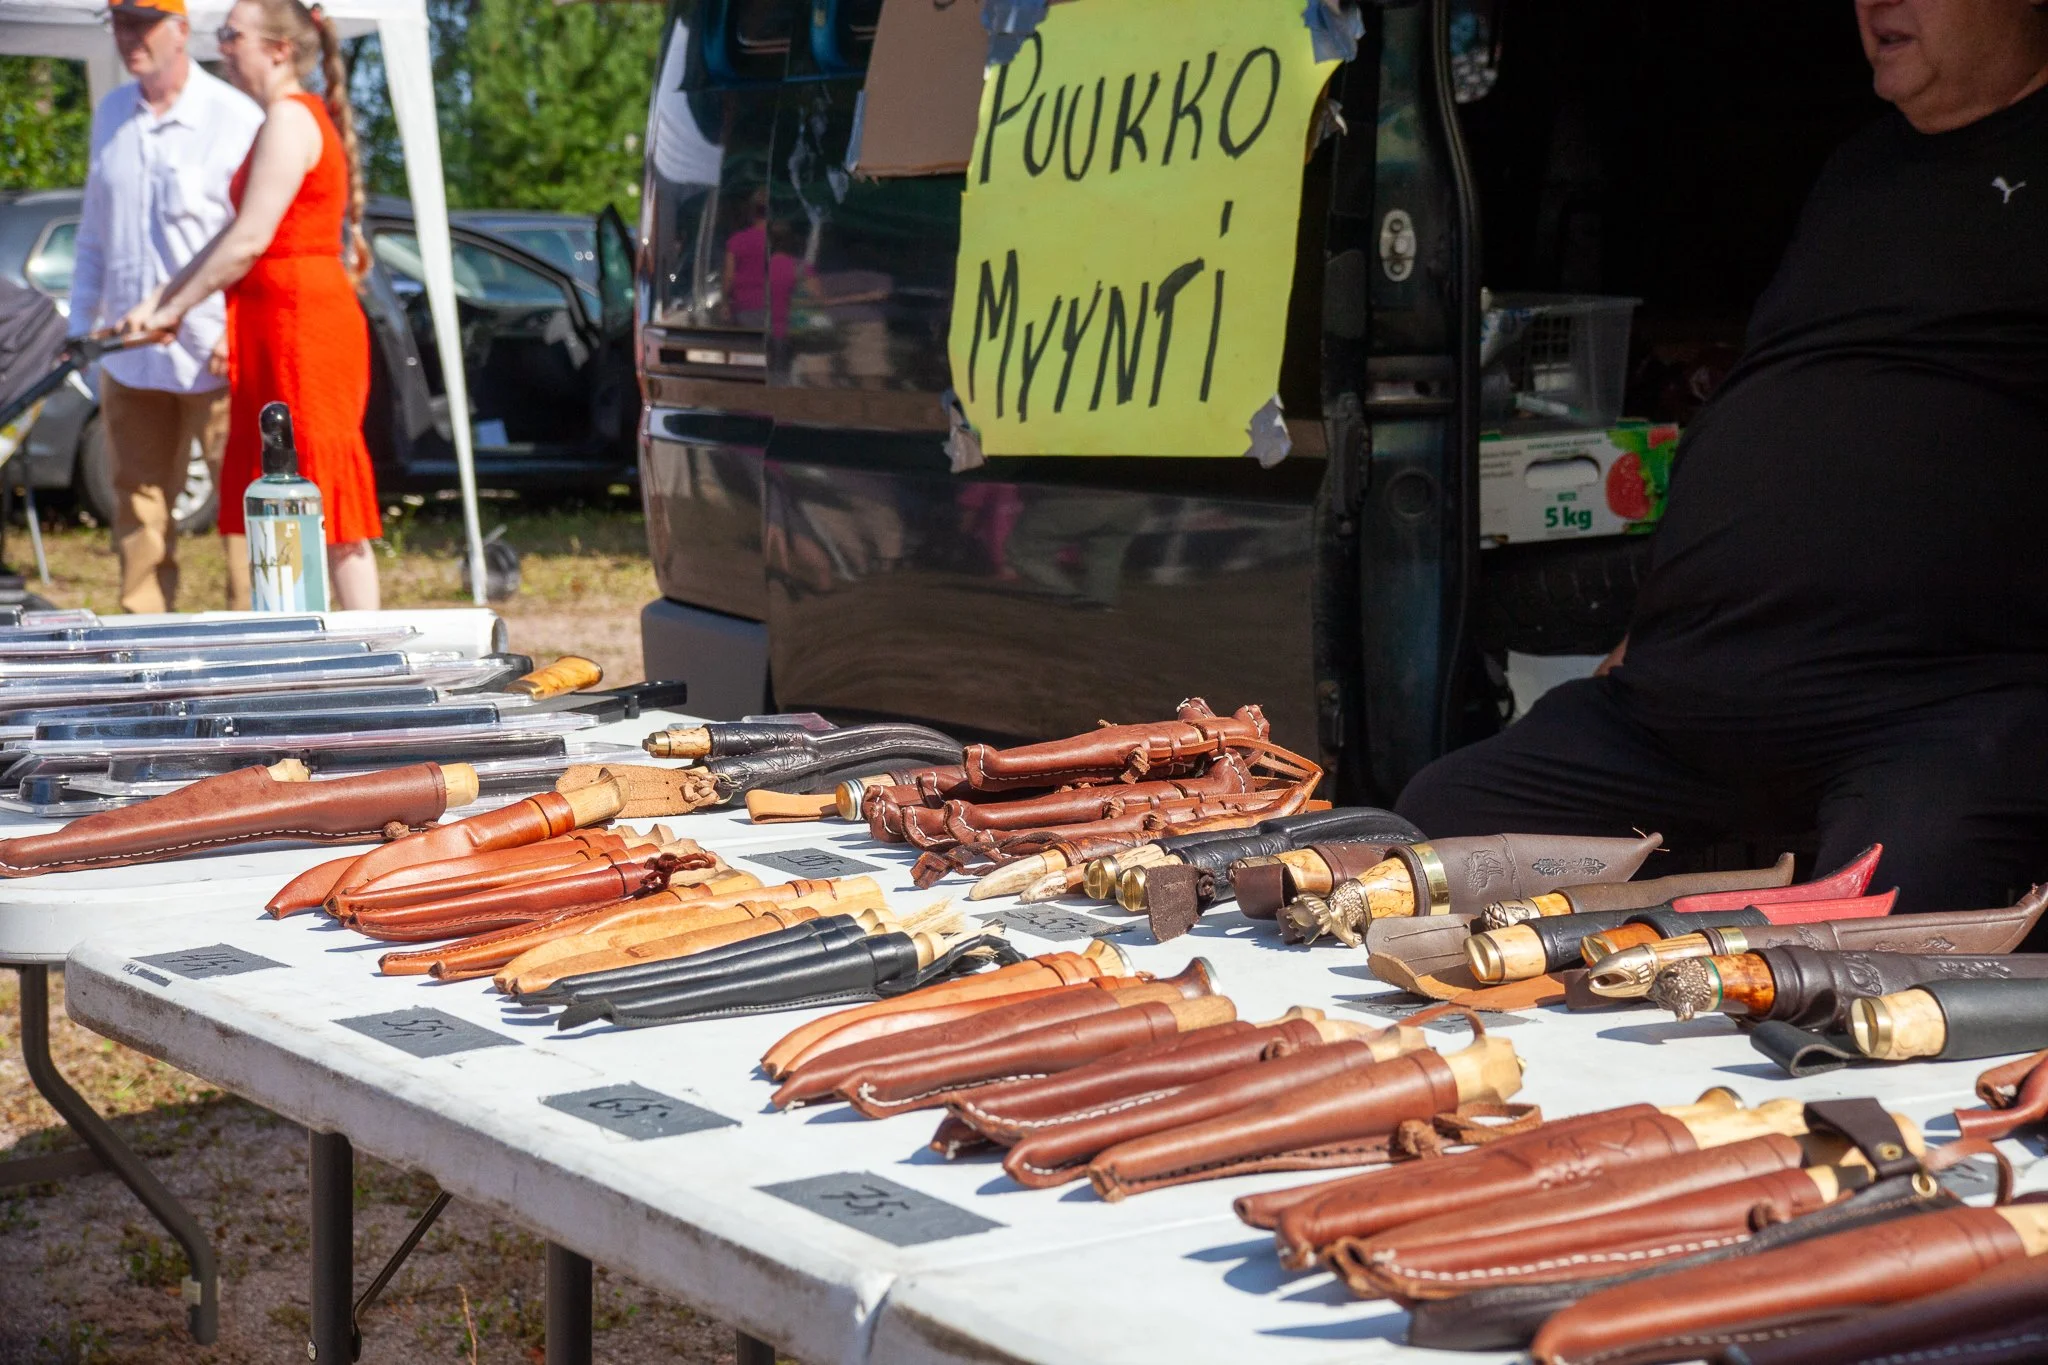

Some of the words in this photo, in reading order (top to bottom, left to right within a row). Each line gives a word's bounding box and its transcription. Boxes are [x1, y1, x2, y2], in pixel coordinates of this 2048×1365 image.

[979, 31, 1281, 184] PUUKKO
[1545, 507, 1559, 529] 5
[1562, 506, 1593, 531] kg
